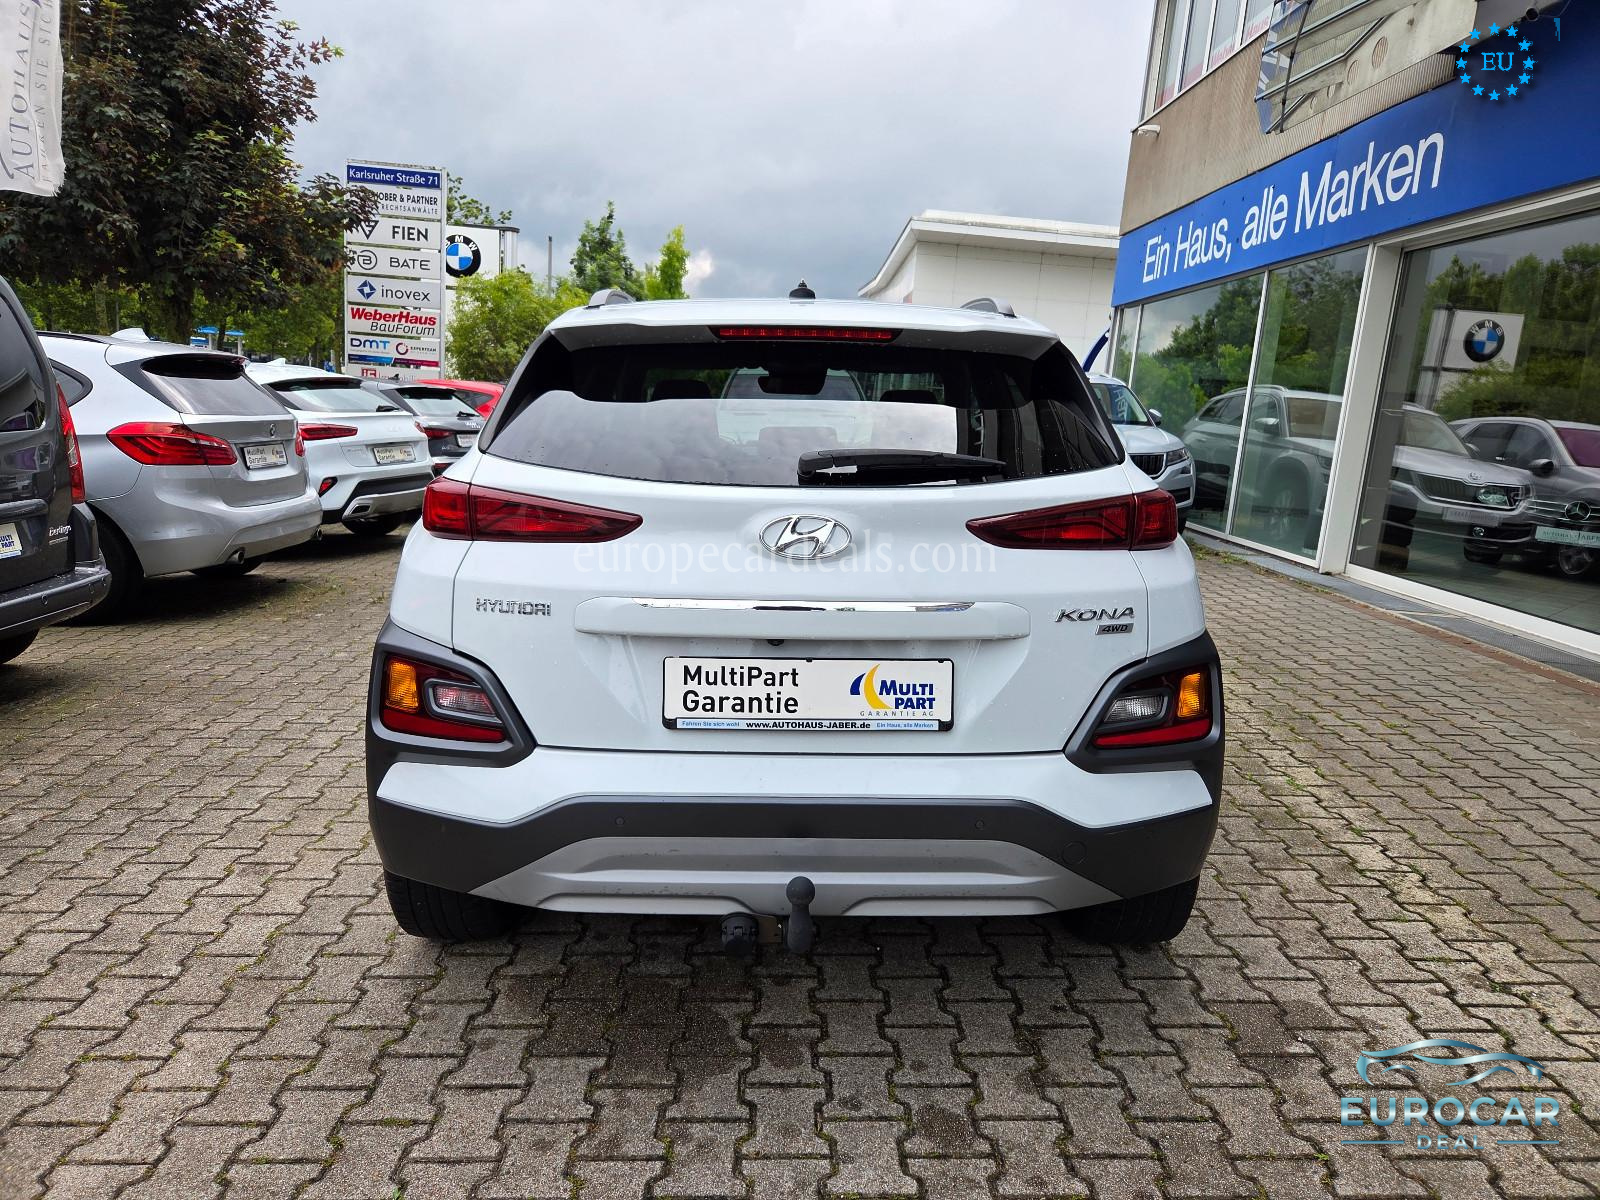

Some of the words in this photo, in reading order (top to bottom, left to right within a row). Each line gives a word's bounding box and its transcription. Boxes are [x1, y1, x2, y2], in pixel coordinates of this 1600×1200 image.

[349, 168, 395, 181] Karlsruher
[396, 172, 426, 185] Straße
[427, 176, 438, 185] 71
[400, 193, 405, 203] &
[406, 194, 438, 206] PARTNER
[381, 203, 438, 214] RECHTSANWÄLTE
[1143, 235, 1169, 283] Ein
[1173, 217, 1232, 273] Haus,
[1241, 185, 1288, 250] alle
[1294, 132, 1444, 234] Marken
[392, 225, 429, 241] FIEN
[389, 257, 431, 270] BATE
[381, 285, 431, 301] inovex
[350, 307, 437, 326] WeberHaus
[370, 322, 435, 336] BauForum
[350, 338, 390, 350] DMT
[475, 598, 551, 616] HYUNDAI
[1055, 607, 1135, 622] KONA
[1101, 624, 1129, 633] 4WD
[683, 665, 799, 687] MultiPart
[879, 679, 934, 696] MULTI
[682, 689, 799, 714] Garantie
[894, 697, 936, 710] PART
[746, 721, 871, 729] www.AUTOHAUS-JABER.de
